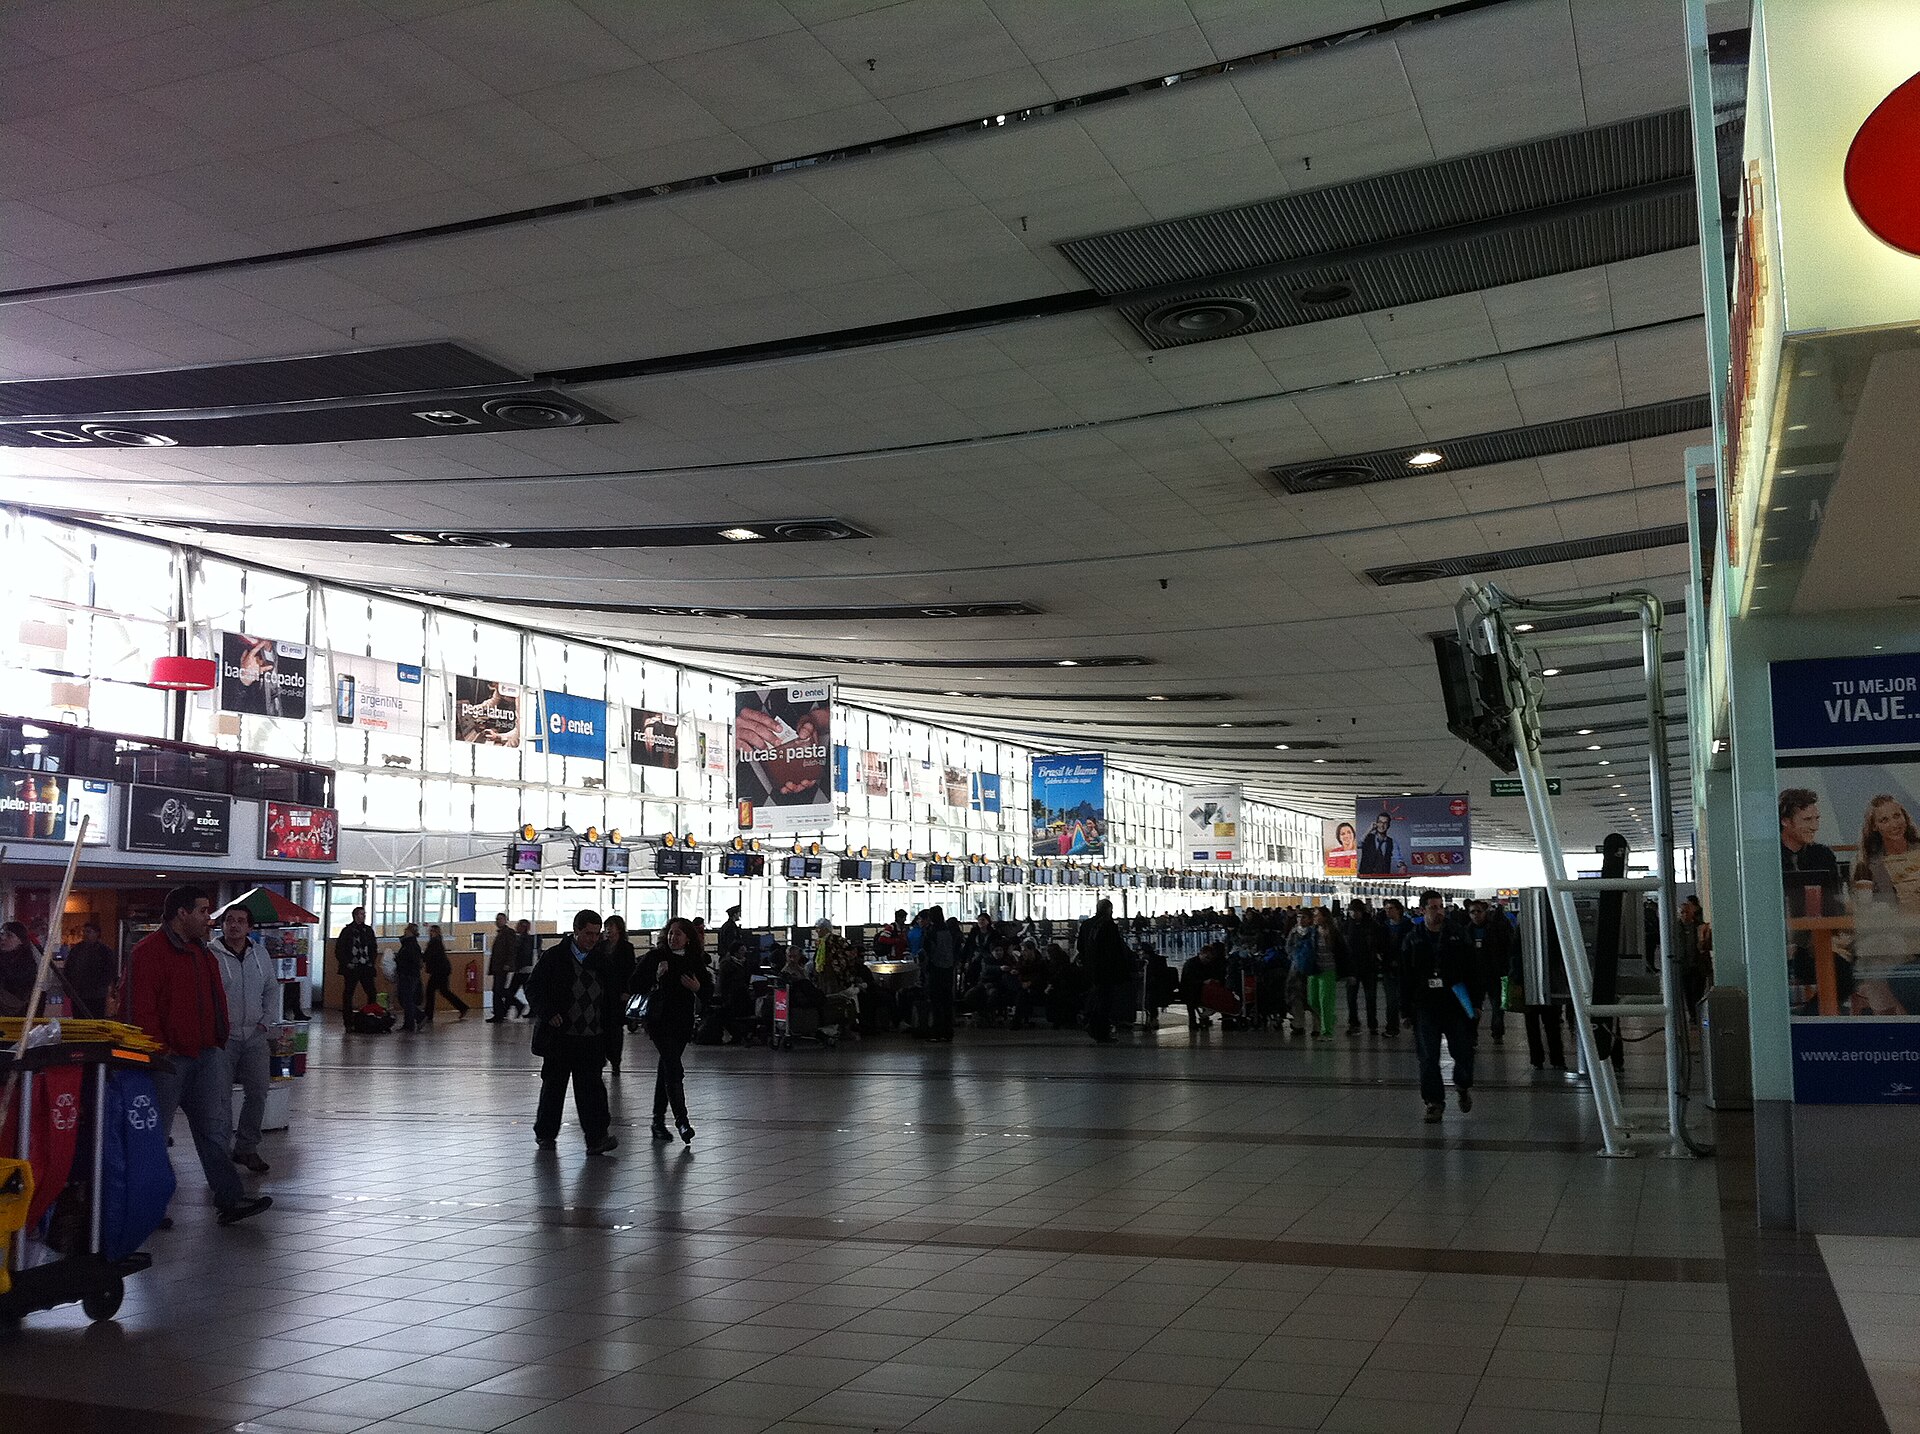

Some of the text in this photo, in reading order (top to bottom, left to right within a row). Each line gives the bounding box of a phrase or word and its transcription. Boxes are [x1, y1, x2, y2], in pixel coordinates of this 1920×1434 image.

[804, 686, 825, 698] entel
[1832, 677, 1917, 696] TU MEJOR
[567, 719, 594, 736] entel
[1038, 765, 1065, 778] Brasil
[1073, 764, 1098, 776] llama
[196, 817, 220, 826] EDOX
